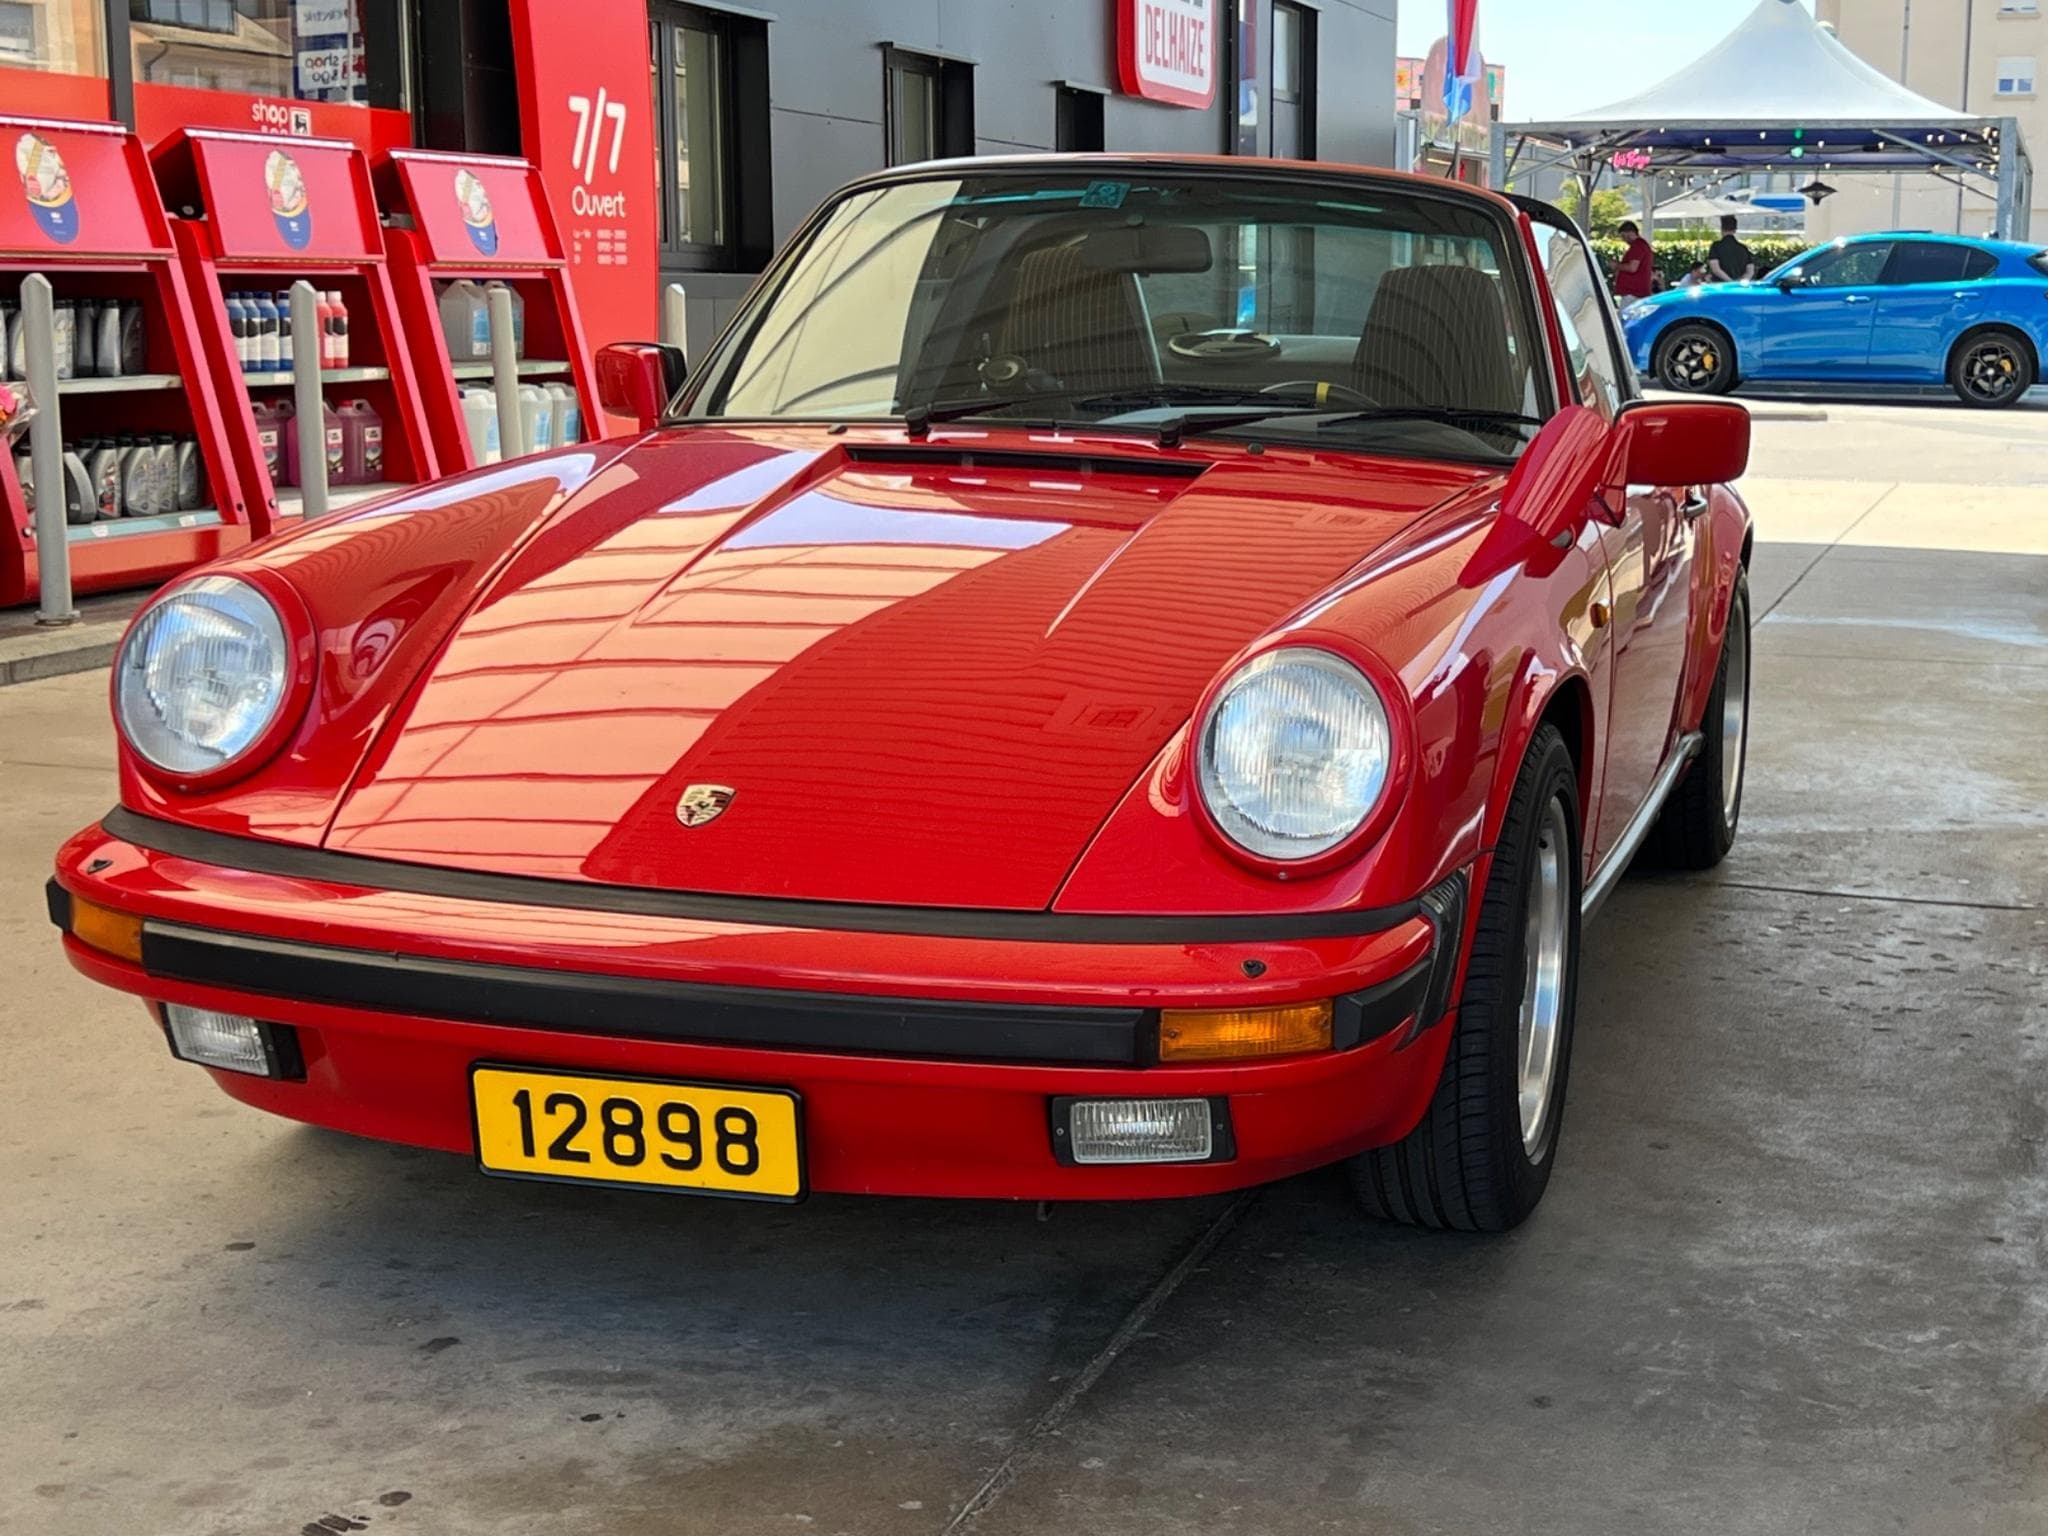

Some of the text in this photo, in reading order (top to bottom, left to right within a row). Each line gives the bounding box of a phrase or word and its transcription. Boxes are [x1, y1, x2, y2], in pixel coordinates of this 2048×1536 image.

[1145, 3, 1204, 78] DELHAIZE
[251, 98, 288, 128] shop
[568, 86, 626, 185] 7/7
[572, 185, 625, 218] Ouvert
[512, 1089, 759, 1176] 12898
